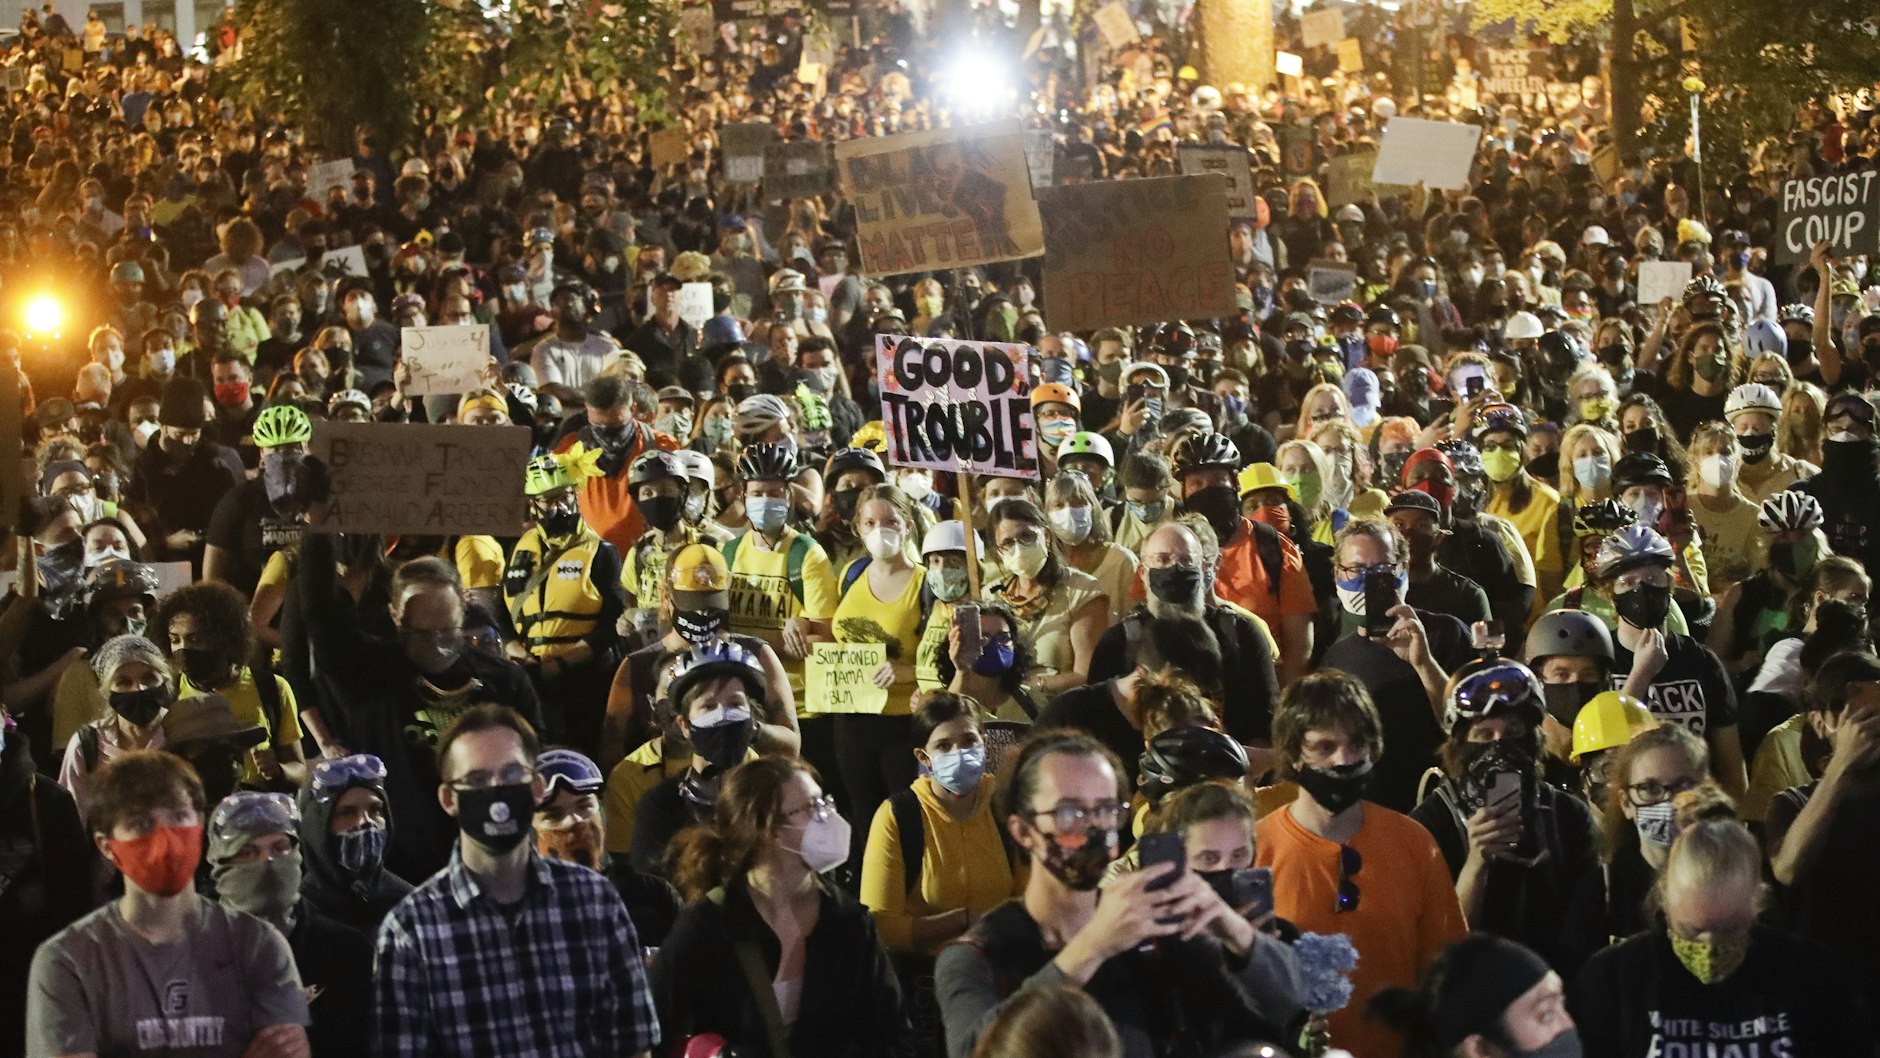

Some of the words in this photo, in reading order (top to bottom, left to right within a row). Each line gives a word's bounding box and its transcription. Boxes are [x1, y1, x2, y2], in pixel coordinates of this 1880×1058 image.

[1783, 170, 1877, 213] FASCIST
[859, 218, 1020, 273] MATTER
[1113, 226, 1175, 269] NO
[1785, 211, 1865, 253] COUP
[1069, 262, 1228, 325] PEACE
[470, 330, 485, 352] 4
[882, 392, 1037, 470] TROUBLE
[729, 591, 787, 619] MAMA
[816, 647, 879, 667] SUMMONED
[825, 668, 866, 687] MAMA
[1708, 1013, 1791, 1040] SILENCE
